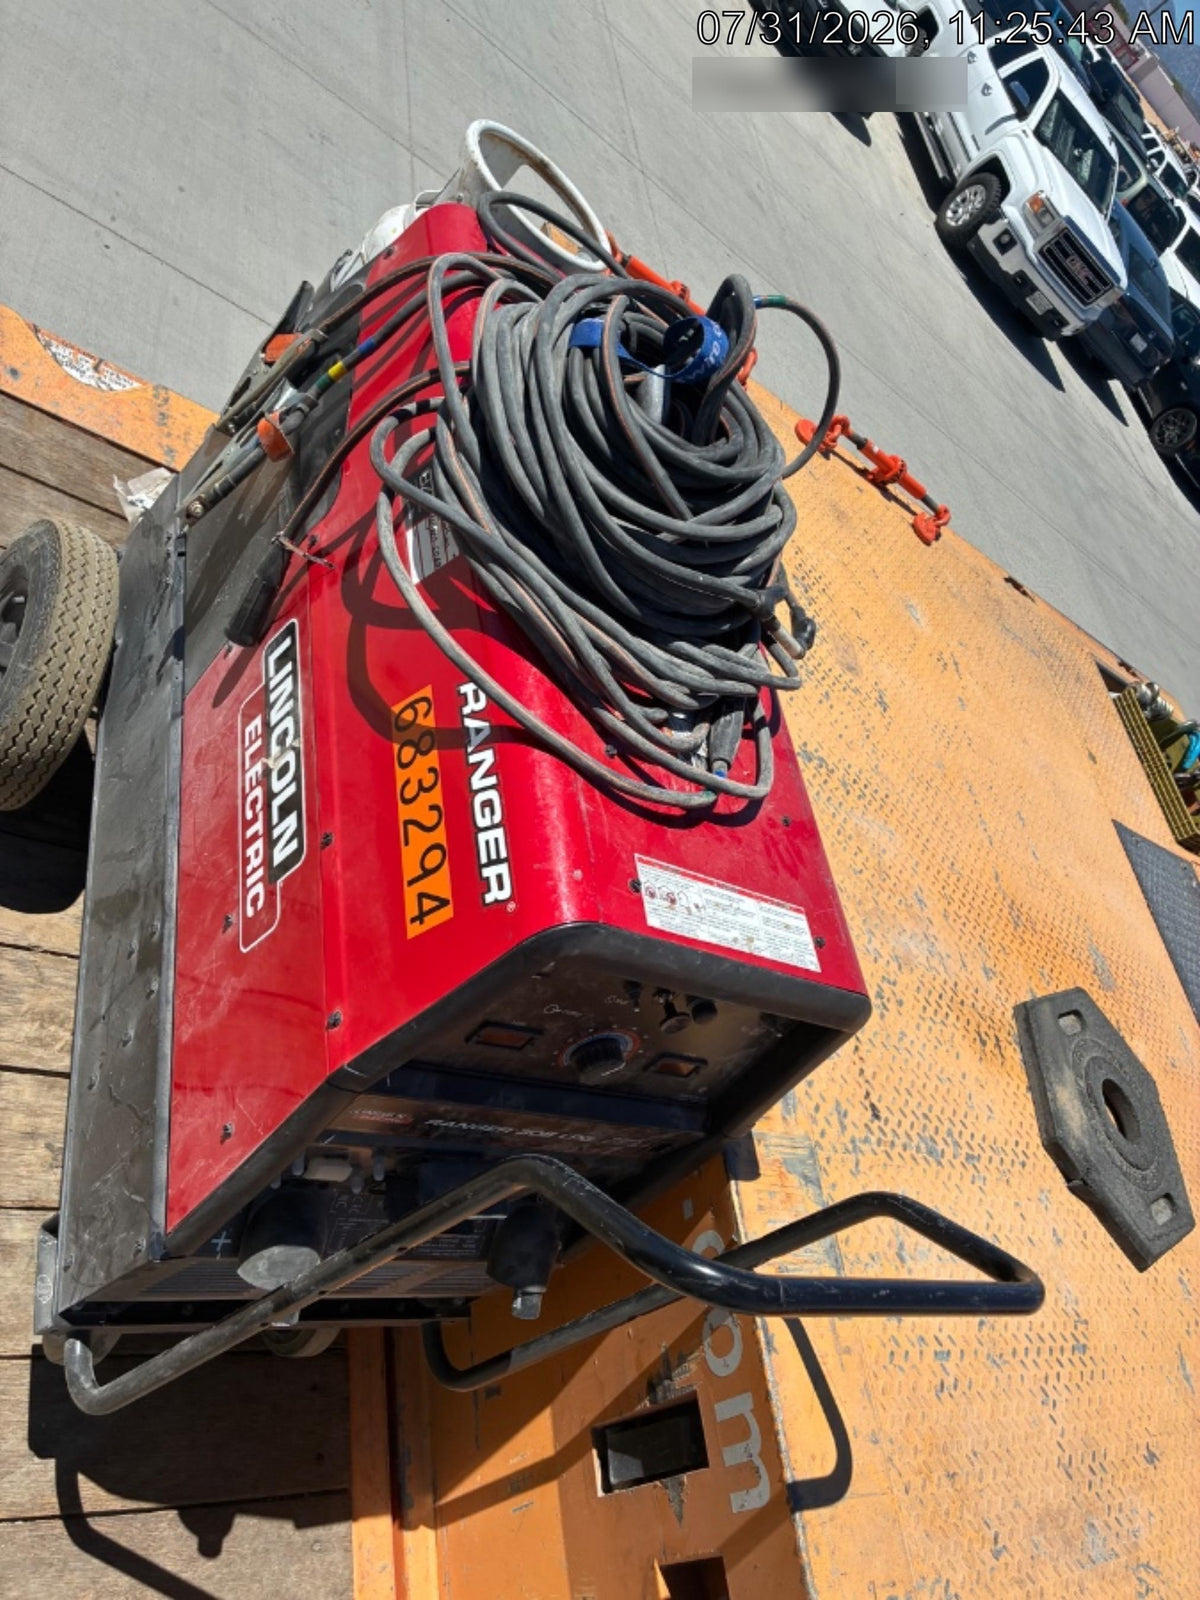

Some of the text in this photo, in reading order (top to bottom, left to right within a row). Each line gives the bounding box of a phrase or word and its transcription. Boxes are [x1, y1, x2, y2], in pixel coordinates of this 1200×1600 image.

[244, 713, 265, 919] ELECTRIC
[267, 636, 299, 867] LINCOLN
[394, 695, 451, 925] 683294
[457, 681, 513, 905] RANGER
